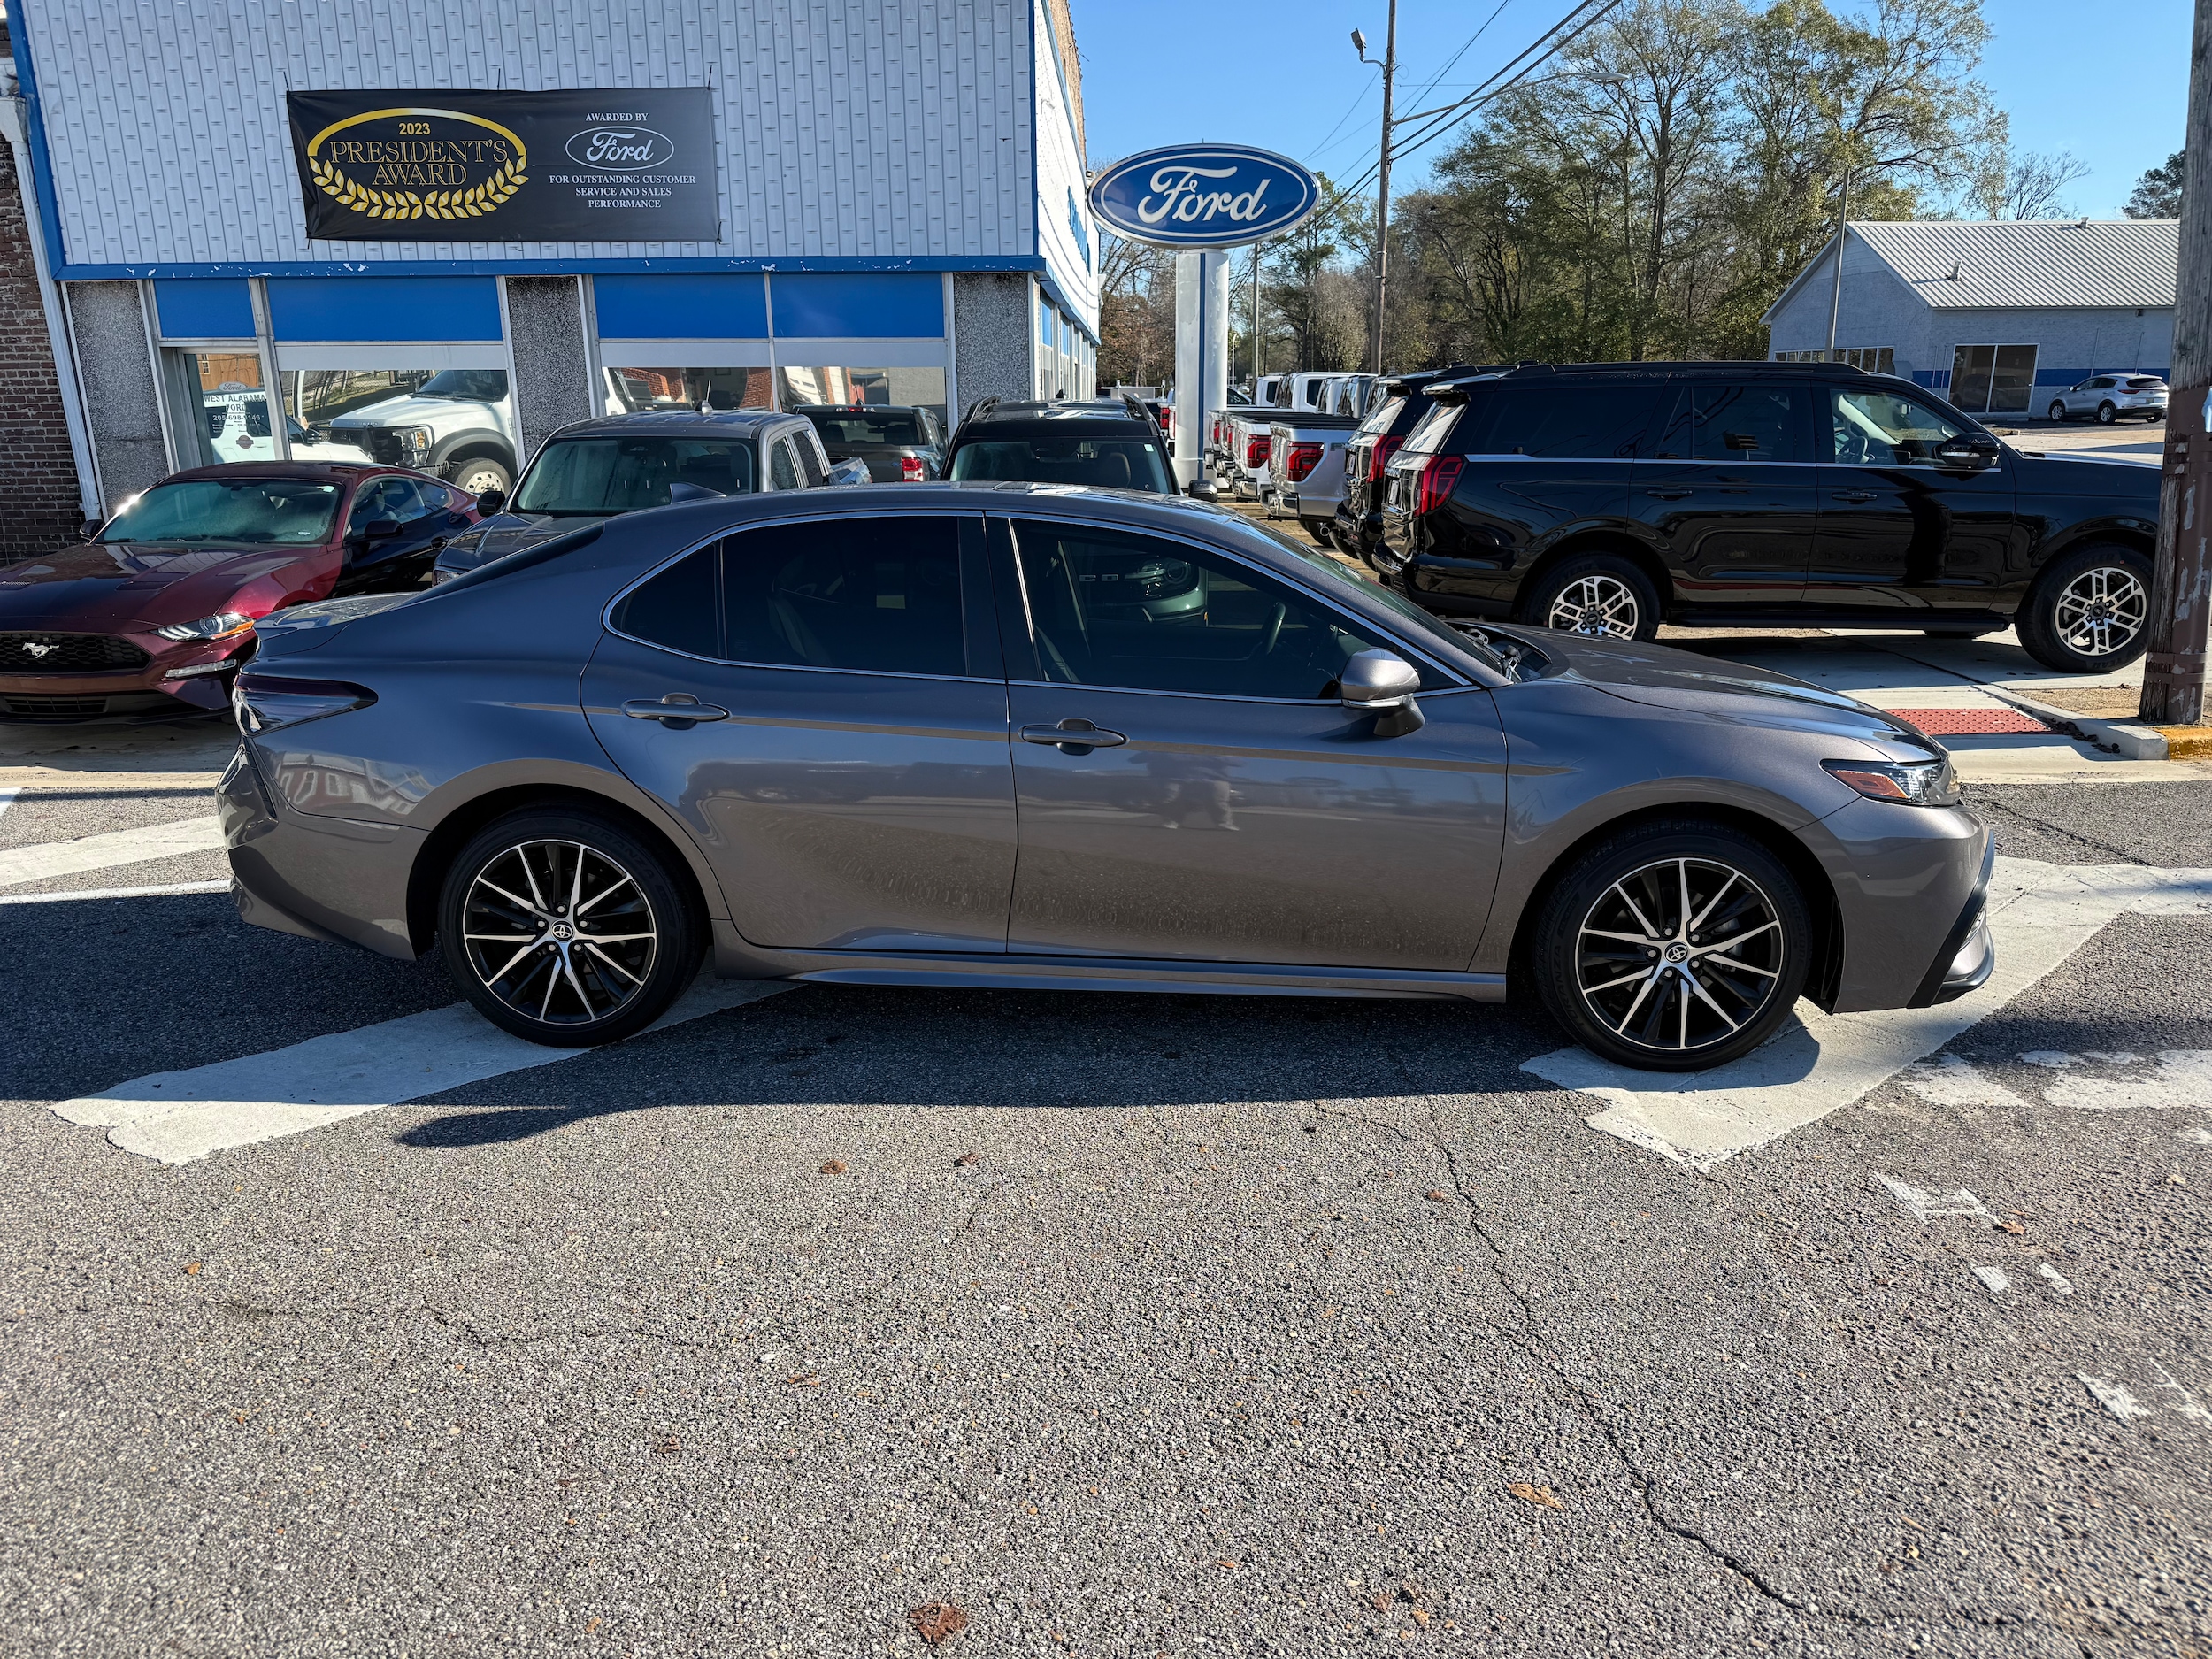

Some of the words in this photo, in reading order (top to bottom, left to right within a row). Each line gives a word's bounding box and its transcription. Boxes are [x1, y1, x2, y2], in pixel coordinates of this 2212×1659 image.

[585, 112, 633, 122] AWARDED
[635, 112, 649, 121] BY
[398, 122, 431, 135] 2023
[329, 139, 509, 164] PRESIDENT'S
[586, 131, 654, 162] Ford
[372, 163, 467, 187] AWARD
[549, 175, 570, 184] FOR
[572, 175, 640, 184] OUTSTANDING
[642, 175, 696, 184] CUSTOMER
[575, 187, 618, 196] SERVICE
[619, 187, 640, 196] AND
[641, 187, 672, 196] SALES
[1137, 165, 1272, 224] Ford
[588, 199, 662, 208] PERFORMANCE
[227, 394, 267, 403] ALABAMA
[575, 822, 656, 879] TURANZA
